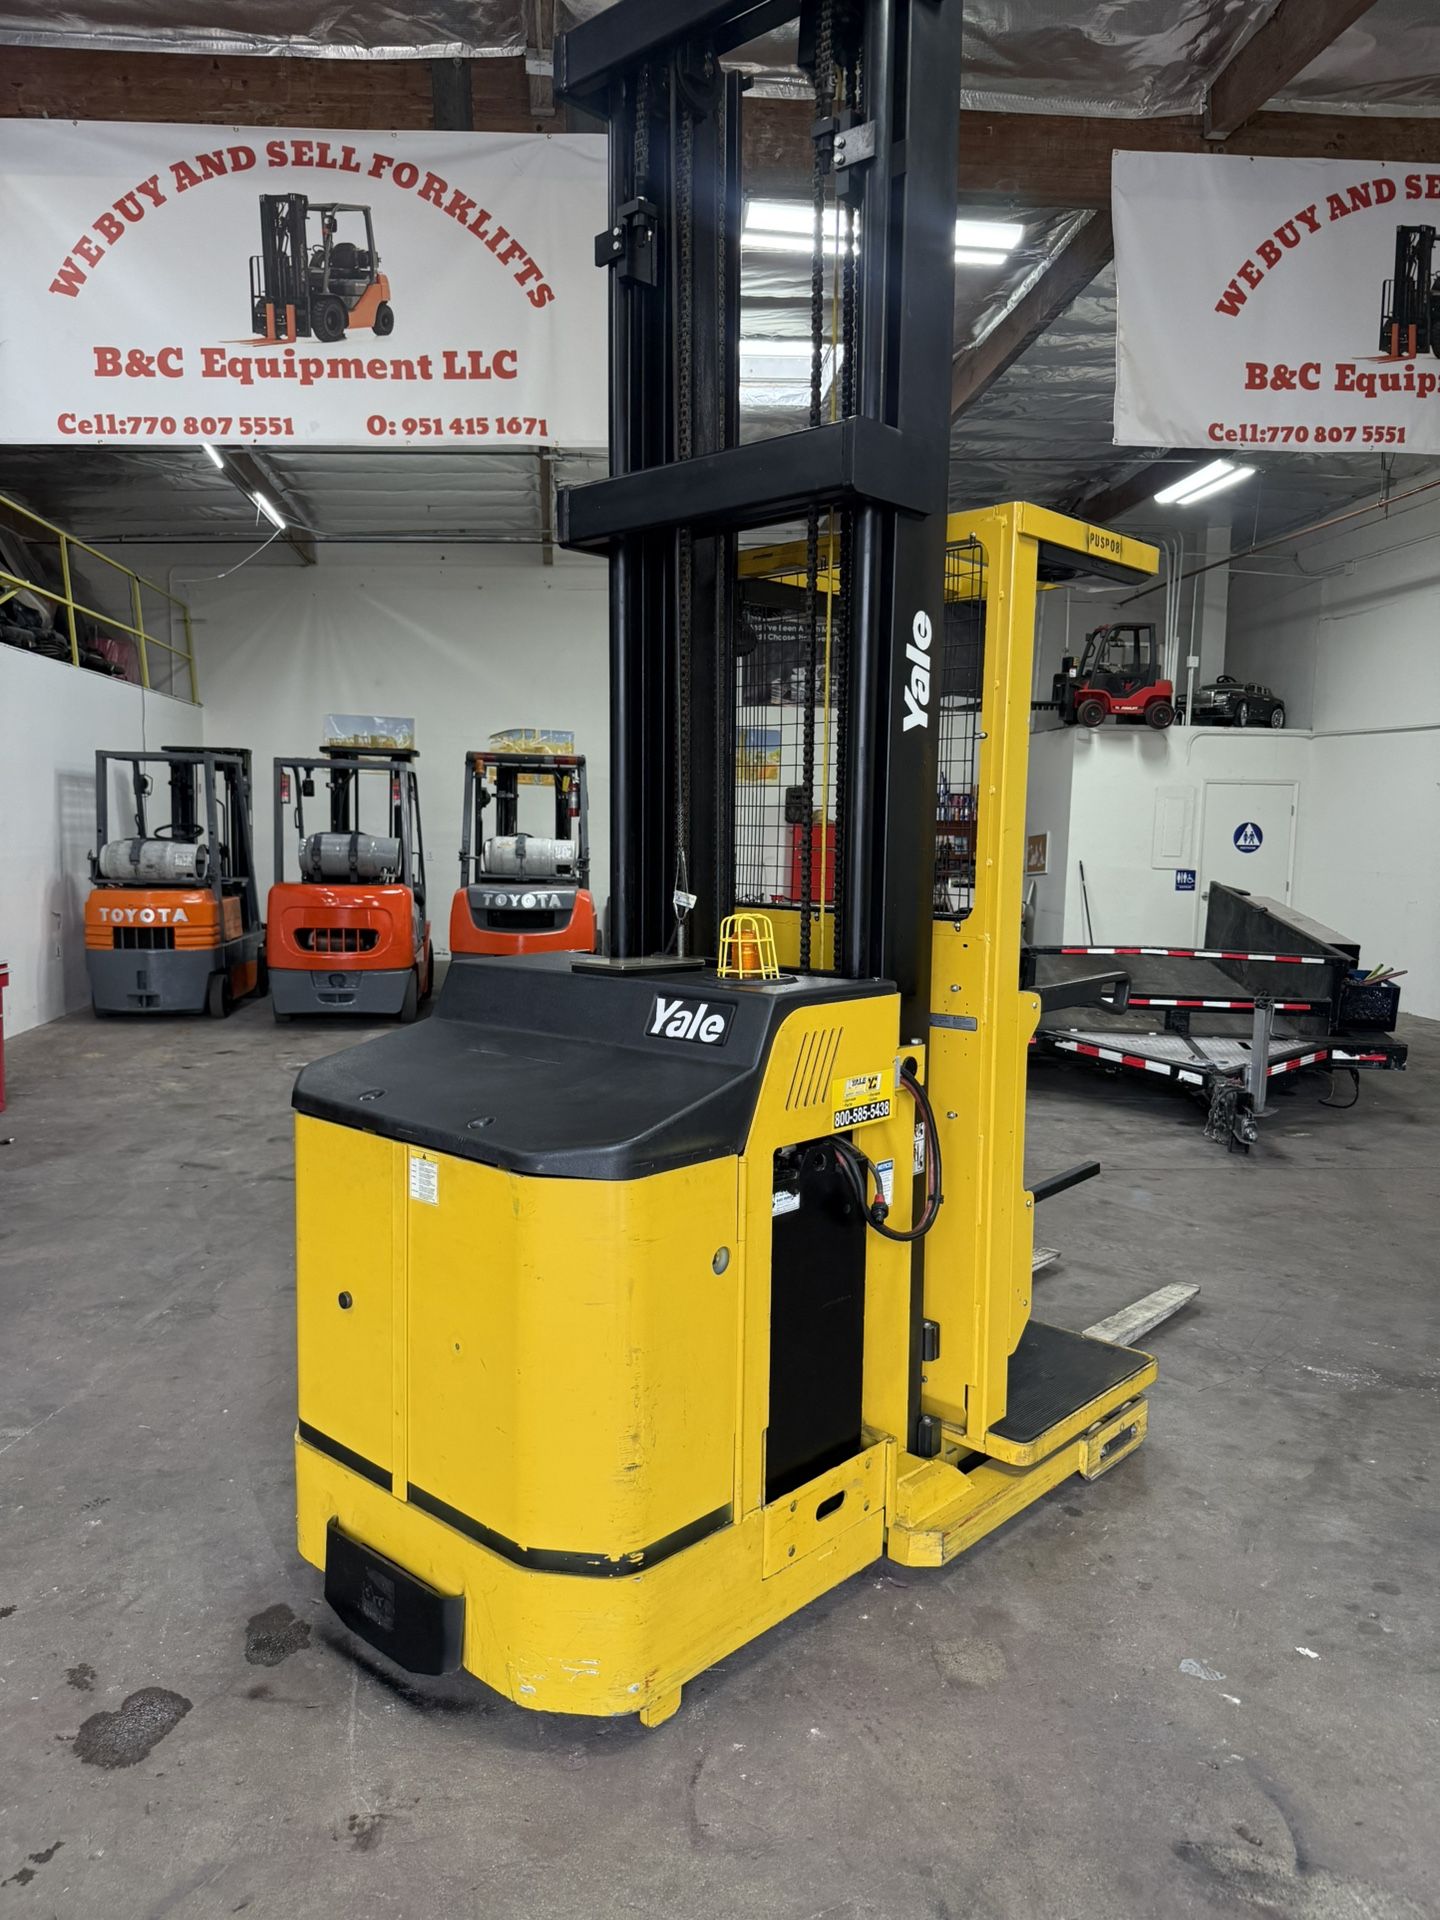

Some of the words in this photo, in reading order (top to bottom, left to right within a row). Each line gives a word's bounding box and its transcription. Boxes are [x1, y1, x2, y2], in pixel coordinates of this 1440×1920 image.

[48, 237, 104, 299] WE
[92, 175, 166, 245] BUY
[170, 145, 257, 193] AND
[265, 140, 360, 173] SELL
[367, 153, 555, 309] FORKLIFTS
[1214, 260, 1264, 318] WE
[1255, 205, 1321, 270] BUY
[1326, 178, 1396, 221] AND
[93, 346, 184, 380] B&C
[200, 347, 433, 386] Equipment
[441, 349, 518, 381] LLC
[1244, 362, 1321, 391] B&C
[1333, 363, 1440, 399] Equip
[183, 416, 233, 437] 807
[238, 416, 294, 437] 5551
[366, 414, 397, 437] O:
[401, 417, 444, 437] 951
[448, 417, 490, 437] 415
[496, 416, 548, 437] 1671
[1313, 425, 1357, 443] 807
[1361, 425, 1406, 444] 5551
[902, 609, 933, 733] Yale
[98, 907, 190, 923] TOYOTA
[482, 893, 562, 909] TOYOTA
[650, 997, 725, 1043] Yale
[834, 1100, 890, 1128] 800-585-5438
